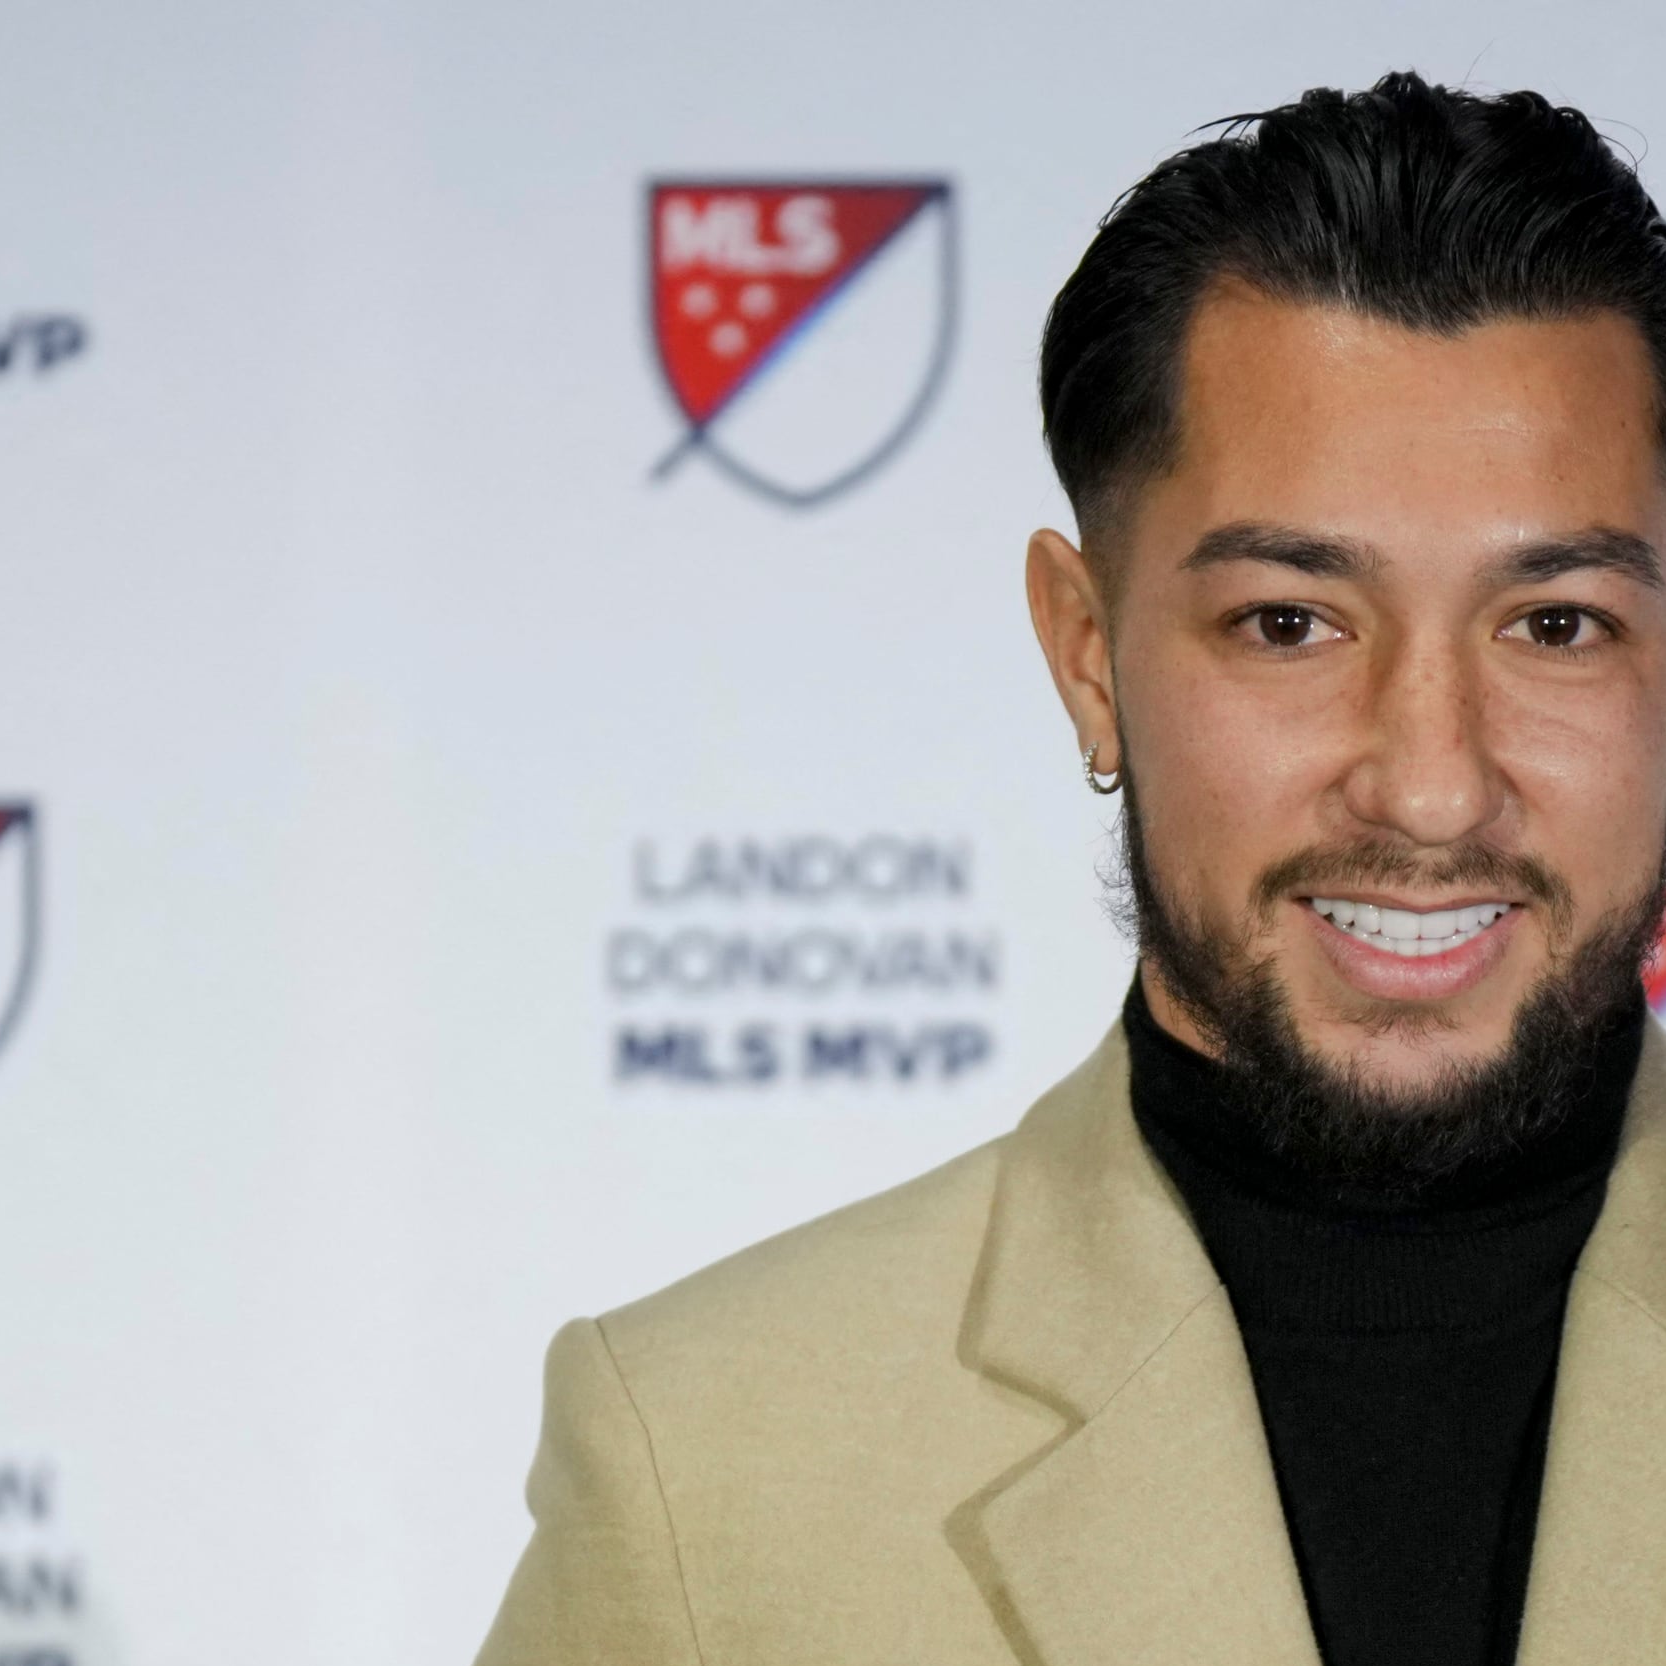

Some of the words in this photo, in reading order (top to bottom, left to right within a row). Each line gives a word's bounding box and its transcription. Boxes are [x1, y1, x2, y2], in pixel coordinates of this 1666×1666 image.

[661, 195, 839, 272] MLS
[635, 832, 971, 901] LANDON
[607, 926, 1001, 996] DONOVAN
[615, 1024, 779, 1083] MLS
[807, 1021, 992, 1081] MVP
